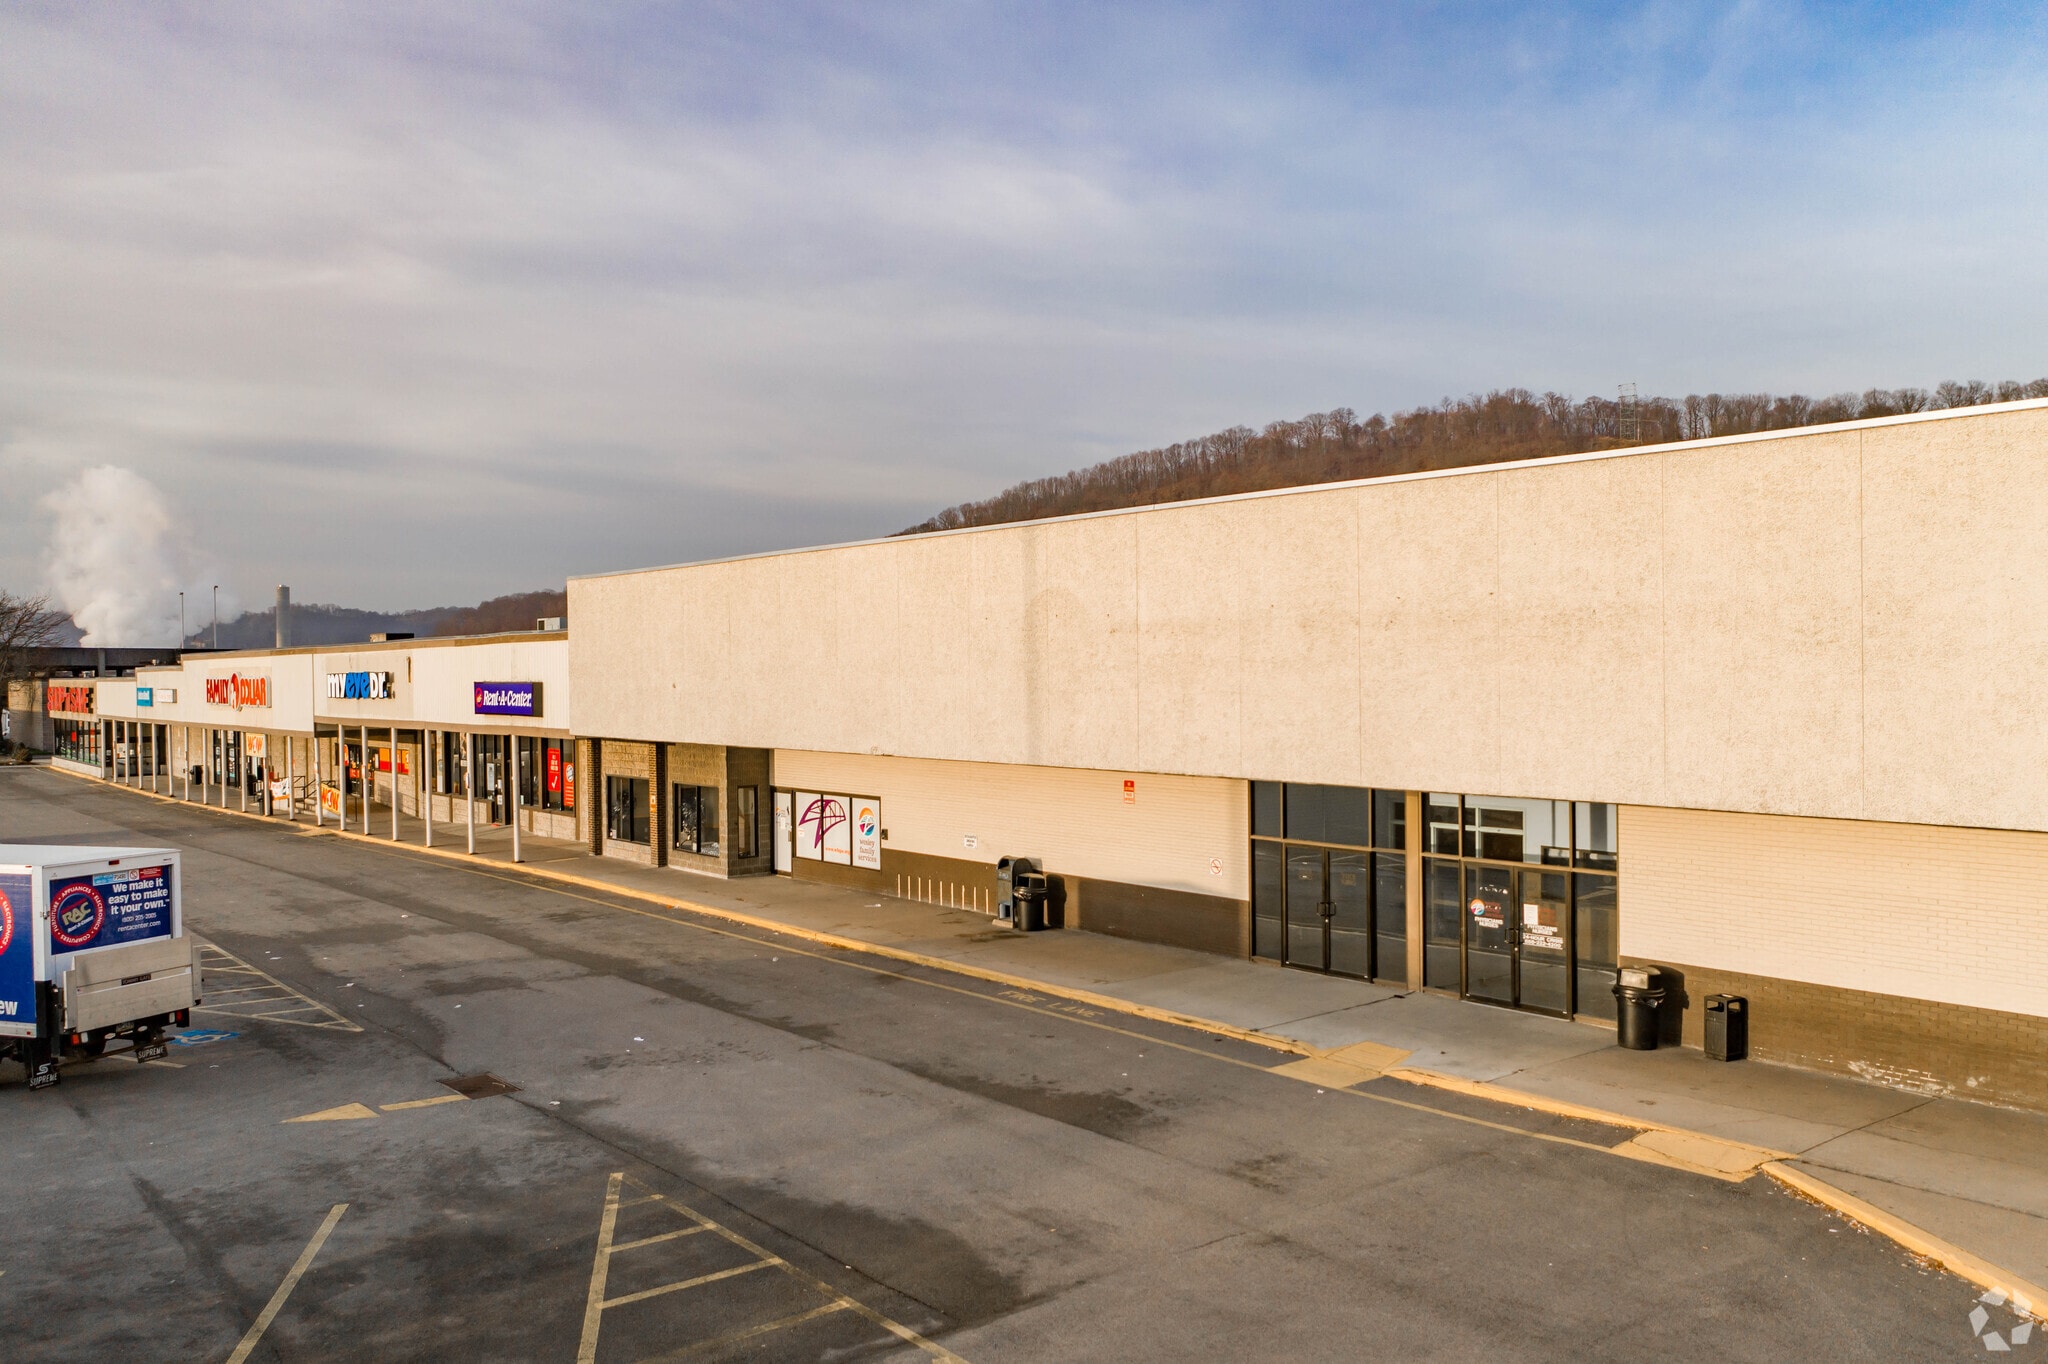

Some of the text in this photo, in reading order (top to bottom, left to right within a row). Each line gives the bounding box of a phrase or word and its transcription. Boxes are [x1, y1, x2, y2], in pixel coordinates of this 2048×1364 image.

[206, 677, 267, 706] FAMILY DOLLAR
[112, 877, 164, 893] We make it
[108, 888, 168, 905] easy to make
[62, 901, 91, 926] RAC
[110, 905, 119, 915] it
[120, 903, 142, 915] your
[117, 920, 161, 932] rentacenter.com
[138, 1045, 164, 1059] SUPREME
[29, 1073, 58, 1087] SUPREME
